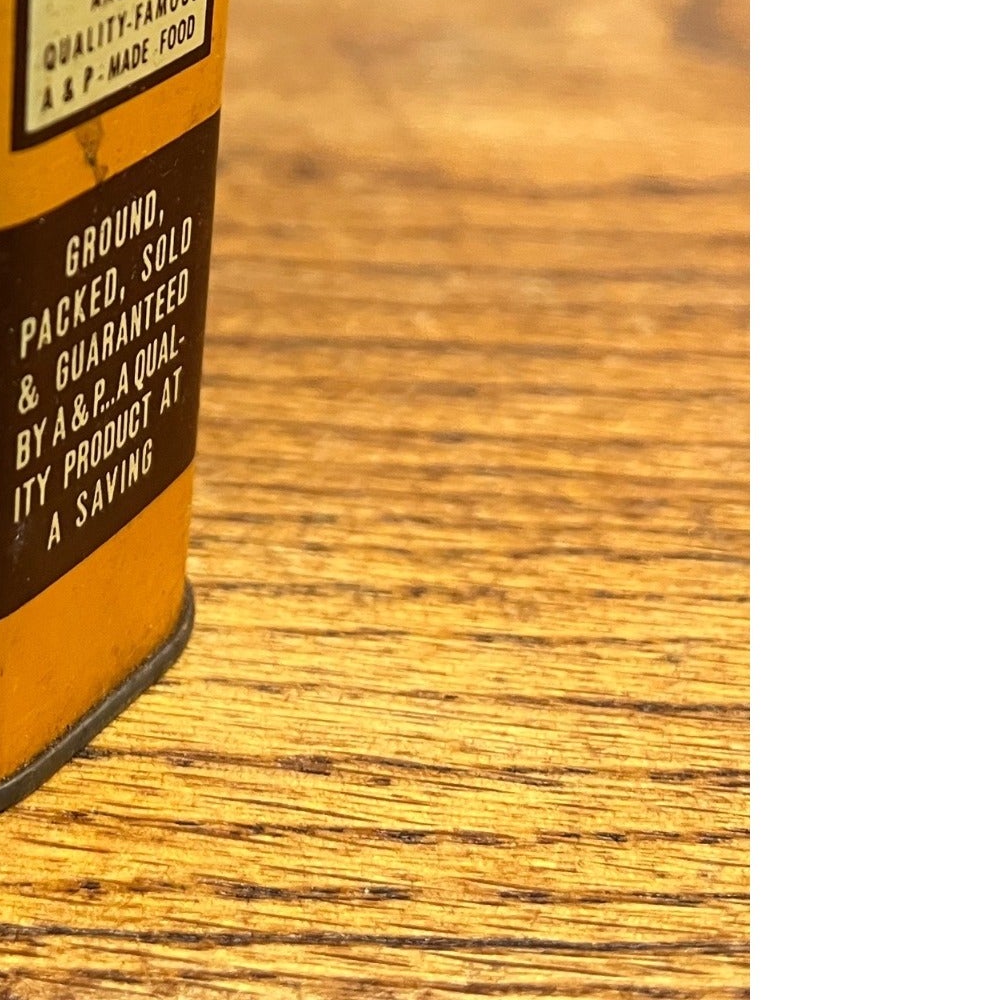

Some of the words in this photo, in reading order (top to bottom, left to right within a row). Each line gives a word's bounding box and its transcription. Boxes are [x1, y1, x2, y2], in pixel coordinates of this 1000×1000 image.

[41, 85, 54, 112] A
[63, 76, 74, 102] &
[160, 14, 195, 54] FOOD
[20, 267, 125, 360] PACKED,
[141, 216, 192, 282] SOLD
[65, 189, 164, 277] GROUND,
[18, 374, 39, 415] &
[55, 268, 189, 392] GUARANTEED
[13, 466, 51, 523] ITY
[64, 391, 152, 489] PRODUCT
[160, 366, 182, 415] AT
[16, 417, 47, 471] BY
[47, 511, 61, 551] A
[76, 439, 153, 527] SAVING
